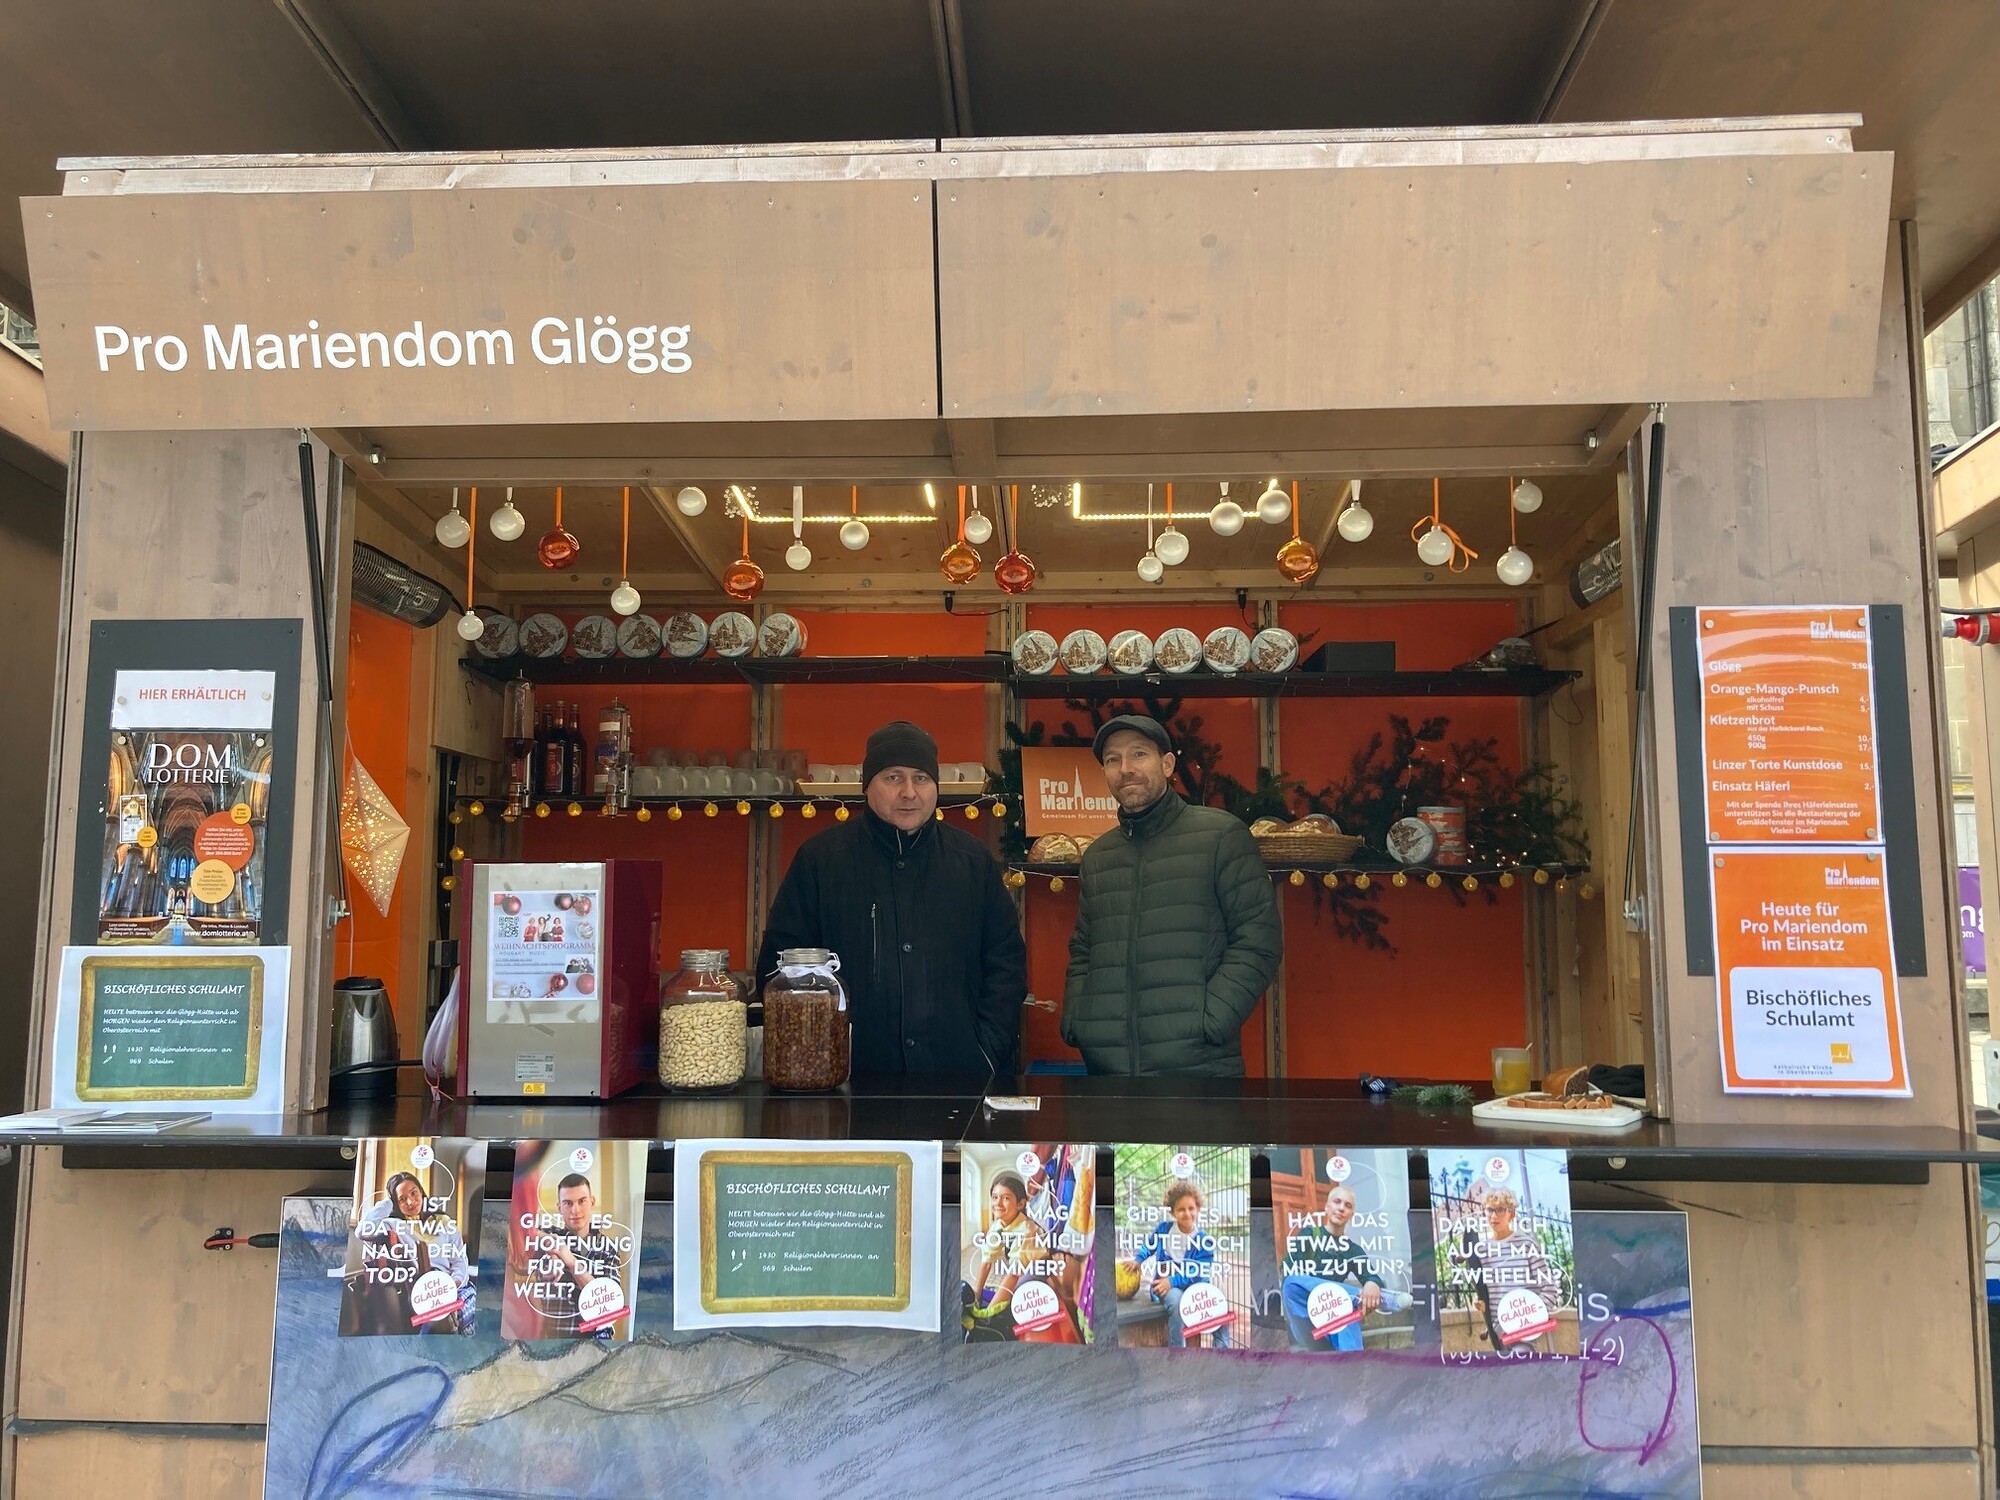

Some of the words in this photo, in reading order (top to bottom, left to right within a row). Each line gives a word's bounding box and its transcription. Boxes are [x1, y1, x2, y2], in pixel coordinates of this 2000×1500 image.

[94, 325, 188, 371] Pro
[203, 320, 515, 370] Mariendom
[531, 316, 692, 374] Glögg
[1810, 620, 1825, 630] Pro
[1709, 661, 1743, 672] Glögg
[139, 689, 167, 699] HIER
[171, 687, 246, 700] ERHÄLTLICH
[1710, 684, 1839, 696] Orange-Mango-Punsch
[1710, 715, 1776, 725] Kletzenbrot
[1748, 742, 1766, 750] 900g
[150, 743, 231, 769] DOM
[1712, 759, 1746, 770] Linzer
[1749, 759, 1781, 770] Torte
[1783, 759, 1843, 770] Kunstdose
[148, 769, 229, 783] LOTTERIE
[1040, 778, 1069, 794] Pro
[1712, 781, 1752, 791] Einsatz
[1755, 781, 1790, 791] Häferl
[1797, 810, 1847, 818] Restaurierung
[1825, 868, 1840, 876] Pro
[1761, 902, 1811, 917] Heute
[1815, 902, 1840, 917] für
[1740, 919, 1769, 934] Pro
[1773, 919, 1868, 934] Mariendom
[1762, 937, 1782, 951] im
[1786, 937, 1845, 952] Einsatz
[104, 984, 186, 995] BISCHÖFLICHES
[188, 984, 245, 995] SCHULAMT
[1746, 990, 1872, 1007] Bischöfliches
[1766, 1011, 1855, 1027] Schulamt
[726, 1182, 822, 1195] BISCHÖFLICHES
[825, 1184, 890, 1196] SCHULAMT
[423, 1197, 450, 1212] IST
[1026, 1205, 1068, 1221] MAG
[1127, 1206, 1172, 1222] GIBT
[1198, 1207, 1220, 1223] ES
[1288, 1212, 1325, 1229] HAT
[1351, 1212, 1389, 1228] DAS
[361, 1221, 388, 1236] DA
[396, 1220, 457, 1235] ETWAS
[520, 1213, 565, 1229] GIBT
[591, 1214, 613, 1229] ES
[802, 1221, 873, 1229] Religionsunterricht
[1440, 1217, 1489, 1233] DARF
[1514, 1217, 1547, 1233] ICH
[525, 1236, 631, 1252] HOFFNUNG
[973, 1232, 1025, 1247] GOTT
[1036, 1232, 1084, 1249] MICH
[1120, 1234, 1179, 1250] HEUTE
[1187, 1235, 1244, 1252] NOCH
[1287, 1236, 1350, 1253] ETWAS
[1361, 1236, 1395, 1251] MIT
[362, 1244, 417, 1259] NACH
[428, 1243, 467, 1259] DEM
[1447, 1242, 1501, 1258] AUCH
[1511, 1243, 1551, 1258] MAL
[528, 1254, 565, 1275] FÜR
[574, 1260, 604, 1275] DIE
[995, 1259, 1066, 1276] IMMER?
[1141, 1261, 1231, 1278] WUNDER?
[1283, 1260, 1317, 1276] MIR
[1321, 1259, 1348, 1276] ZU
[1352, 1259, 1404, 1275] TUN?
[366, 1267, 416, 1283] TOD?
[1451, 1268, 1562, 1284] ZWEIFELN?
[424, 1278, 440, 1290] ICH
[514, 1282, 575, 1298] WELT?
[592, 1285, 606, 1297] ICH
[1023, 1289, 1039, 1301] ICH
[1192, 1290, 1208, 1303] ICH
[1318, 1290, 1333, 1303] ICH
[1510, 1296, 1526, 1309] ICH
[431, 1299, 443, 1308] JA.
[598, 1306, 610, 1315] JA.
[1031, 1309, 1044, 1319] JA.
[1200, 1311, 1212, 1320] JA.
[1327, 1311, 1338, 1321] JA.
[1520, 1318, 1533, 1327] JA.
